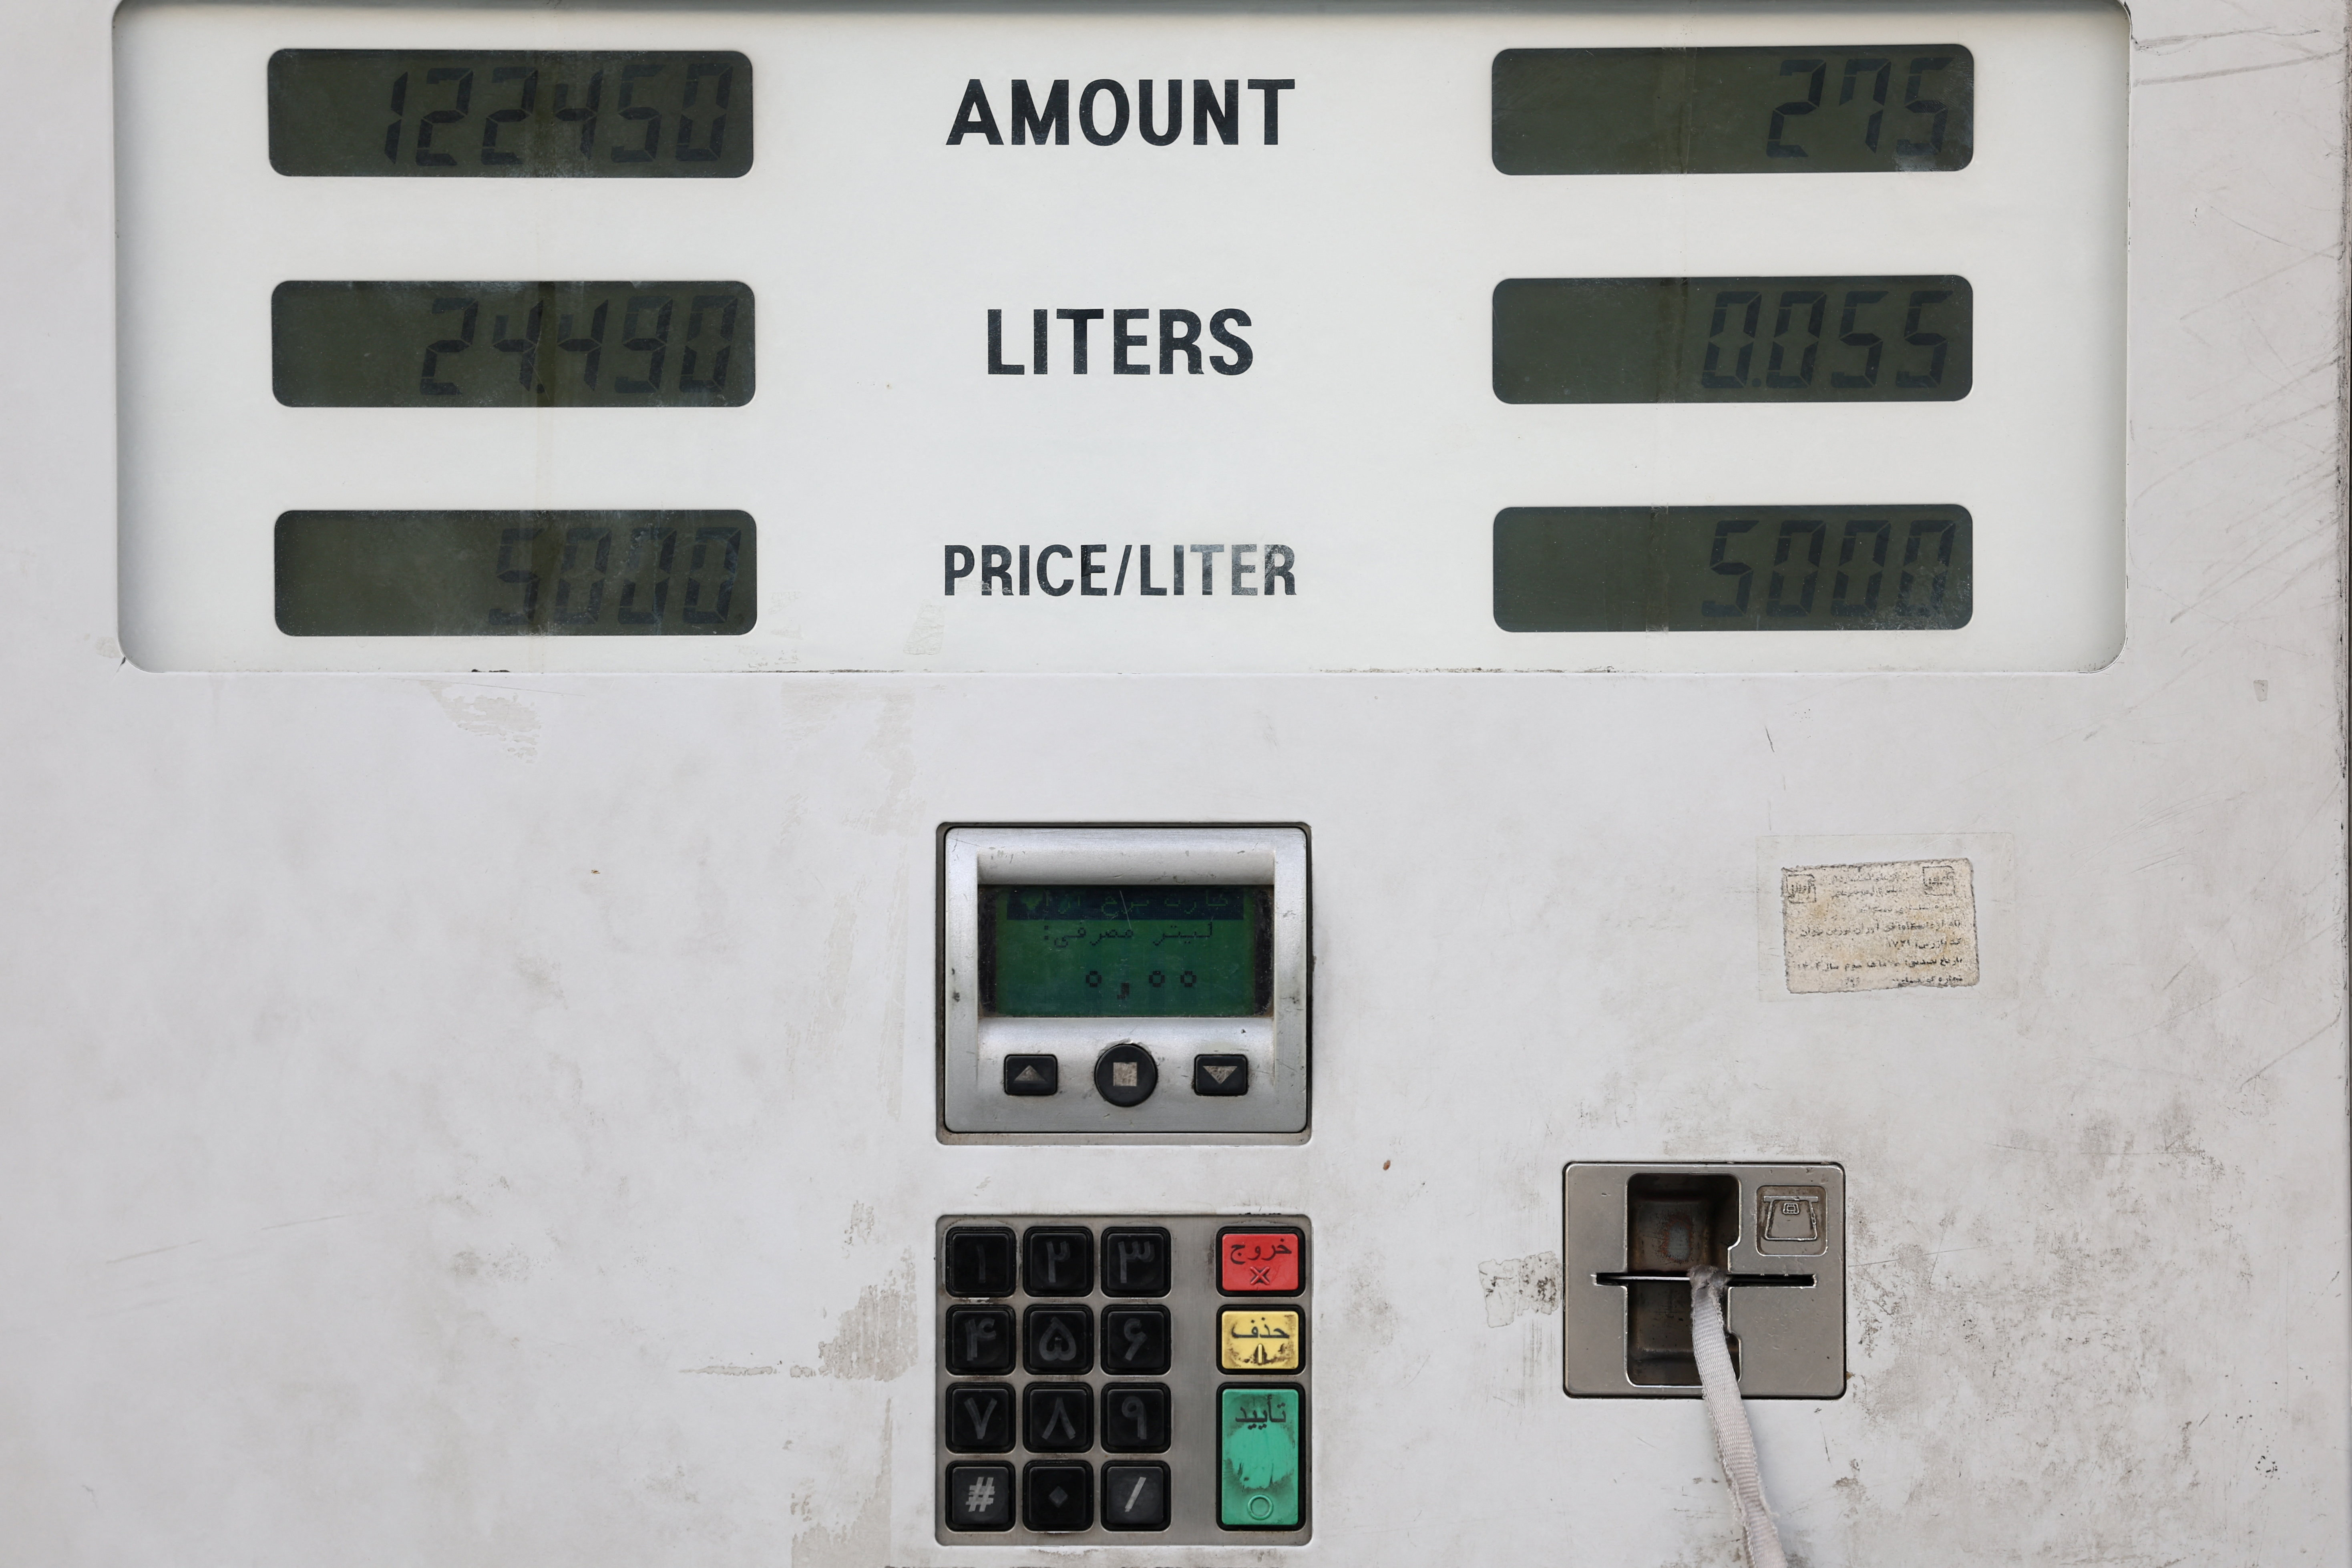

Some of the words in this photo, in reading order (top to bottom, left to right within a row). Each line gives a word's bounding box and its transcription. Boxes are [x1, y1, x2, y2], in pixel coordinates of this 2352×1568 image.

[384, 63, 731, 166] 122450
[945, 78, 1295, 146] AMOUNT
[1766, 57, 1954, 158] 275
[420, 296, 738, 395] 24.490
[987, 308, 1253, 375] LITERS
[1701, 291, 1954, 388] 0.055
[488, 527, 740, 625] 5000
[944, 544, 1297, 596] PRICE/LITER
[1701, 520, 1956, 617] 5000
[1153, 922, 1213, 946] لیتر
[1047, 1241, 1071, 1284] ۲
[1118, 1241, 1155, 1284] ۳
[1230, 1238, 1292, 1265] خروج
[965, 1317, 996, 1361] ۴
[1039, 1317, 1077, 1362] ۵
[1123, 1318, 1147, 1362] ۶
[1231, 1317, 1290, 1339] حذف
[964, 1397, 997, 1440] ۷
[1041, 1397, 1076, 1440] ۸
[1121, 1396, 1147, 1440] ۹
[1235, 1394, 1287, 1430] تأیید
[965, 1476, 995, 1512] #
